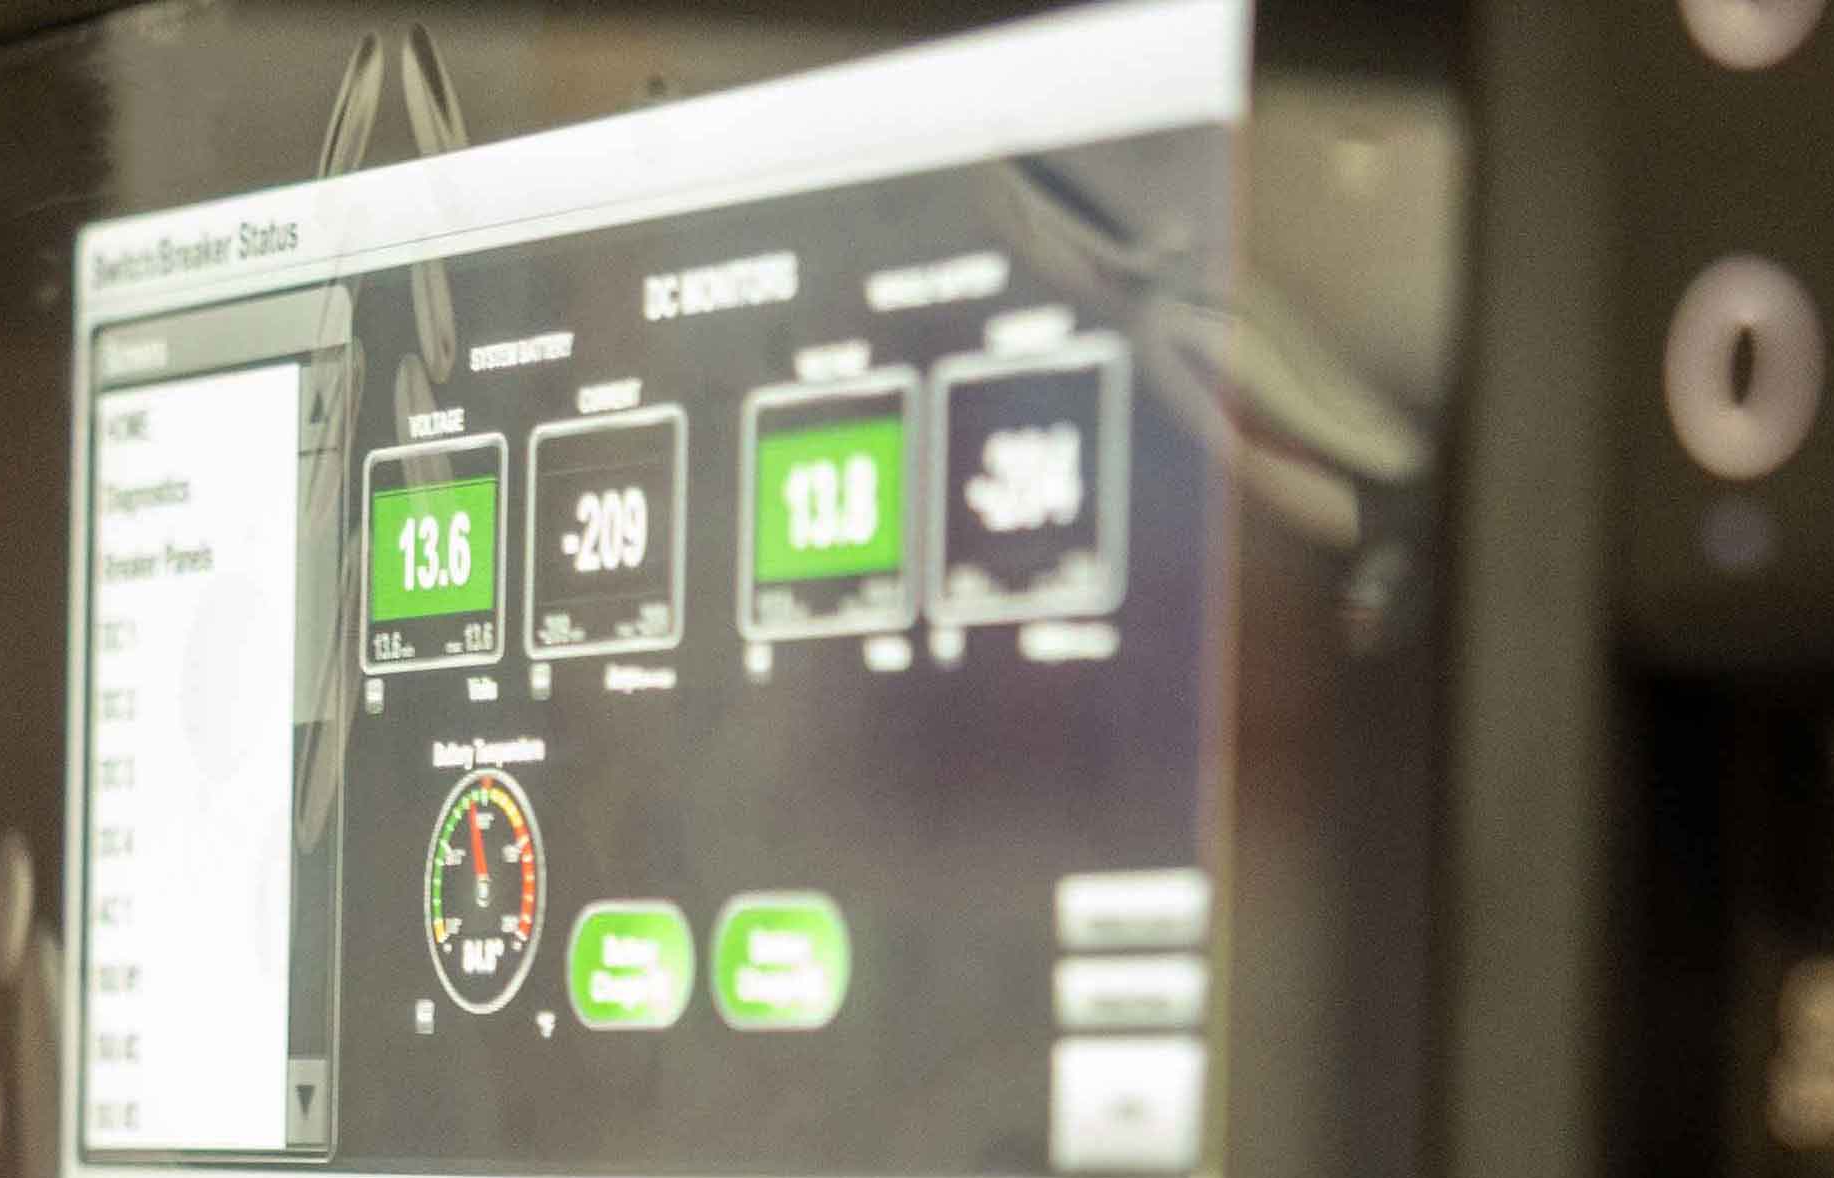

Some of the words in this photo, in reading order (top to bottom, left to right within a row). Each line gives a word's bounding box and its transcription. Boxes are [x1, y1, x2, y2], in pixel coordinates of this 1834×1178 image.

[238, 219, 300, 260] Status
[561, 486, 644, 574] -209
[398, 510, 471, 592] 13.6
[372, 631, 402, 661] 13.6
[464, 621, 491, 652] 13.6
